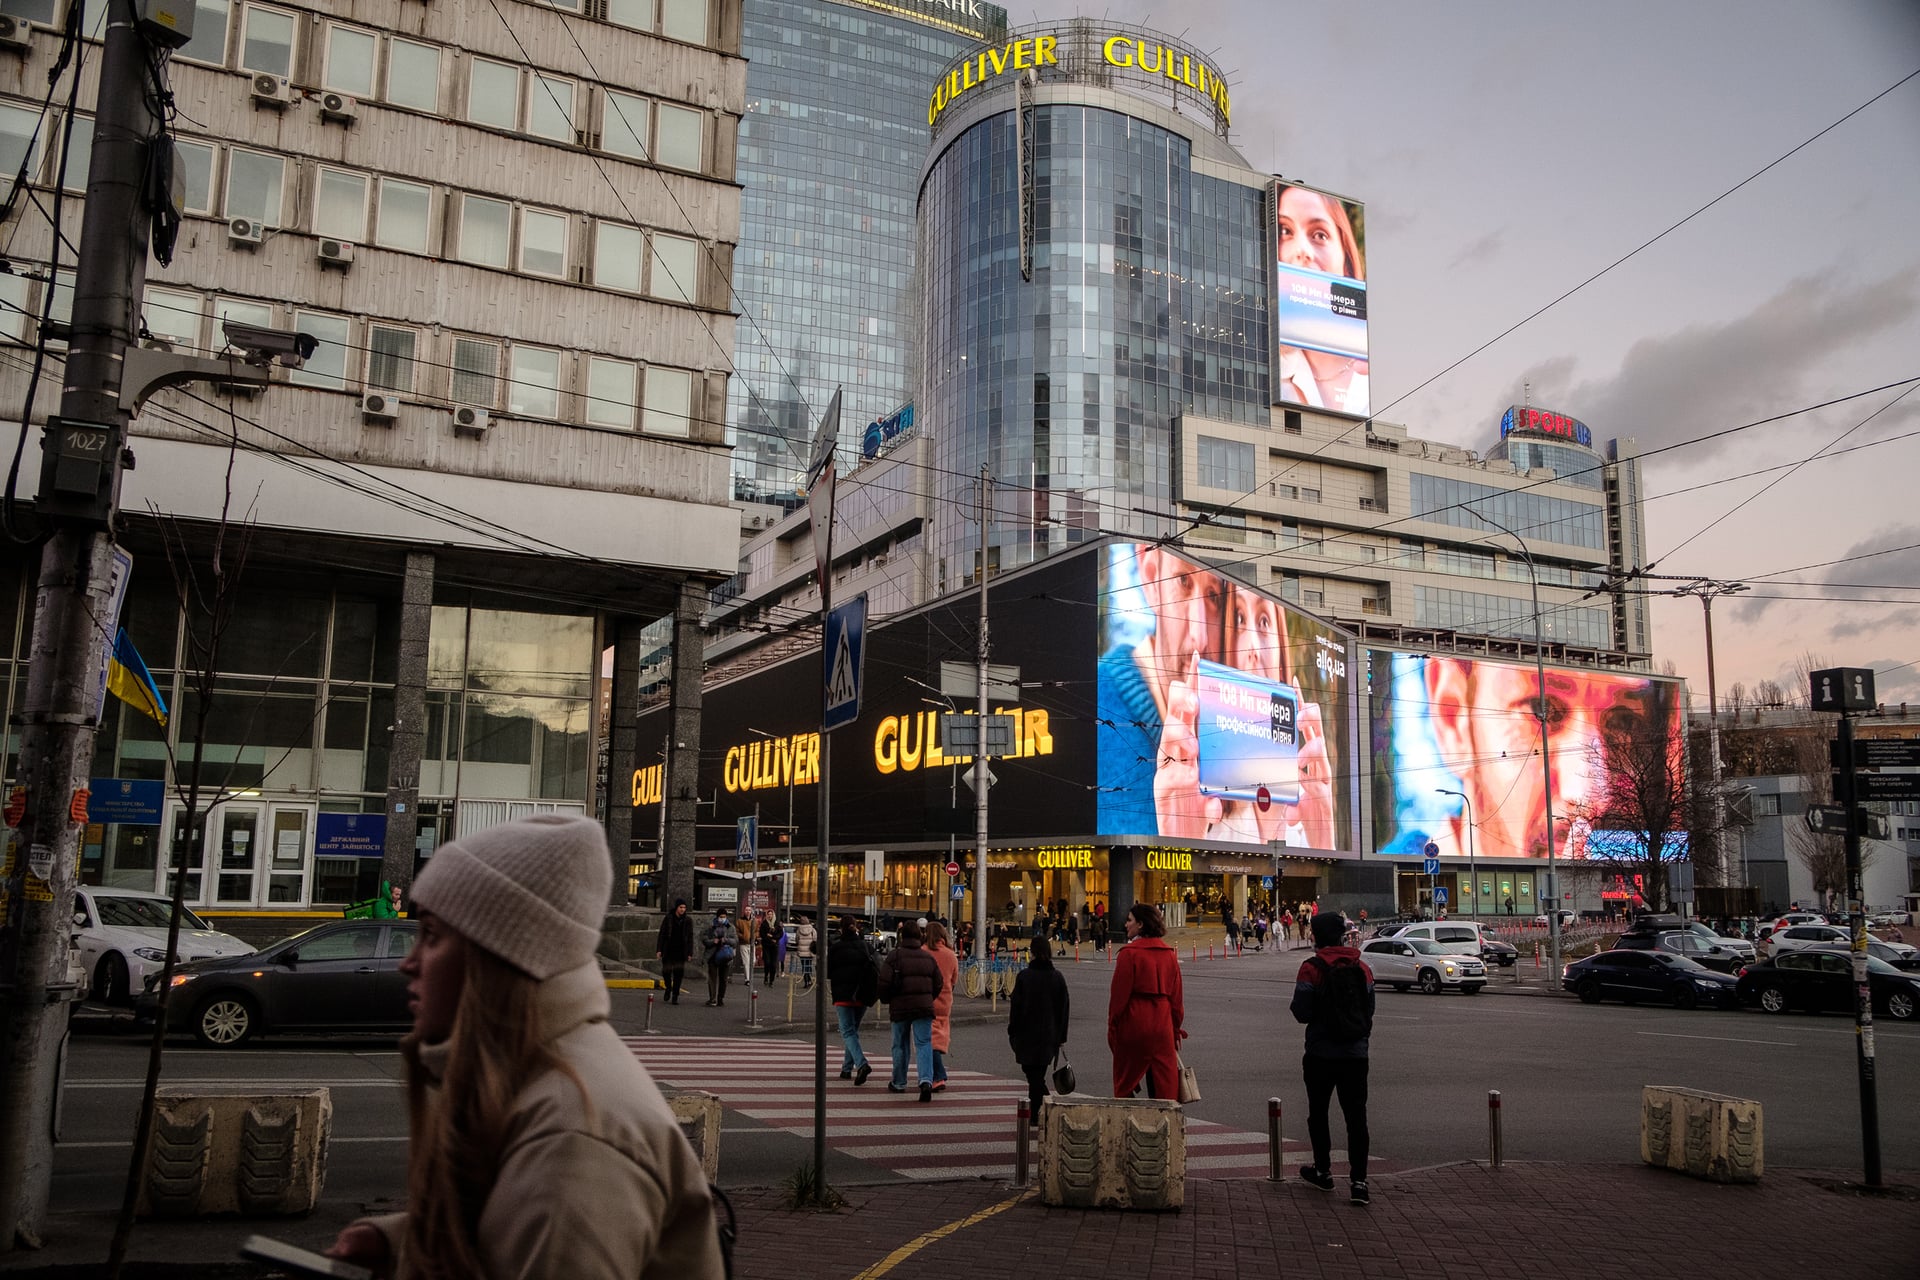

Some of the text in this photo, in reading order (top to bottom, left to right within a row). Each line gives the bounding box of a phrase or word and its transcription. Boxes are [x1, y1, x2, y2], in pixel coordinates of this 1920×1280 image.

[928, 35, 1058, 126] GULLIVER
[1324, 293, 1356, 306] камера
[1519, 408, 1573, 438] SPORT
[67, 431, 107, 451] 1027
[1219, 683, 1291, 723] 108 Мп камера
[1216, 714, 1292, 745] професійного рівня
[724, 732, 821, 793] GULLIVER
[1038, 850, 1093, 868] GULLIVER
[1147, 851, 1192, 870] GULLIVER
